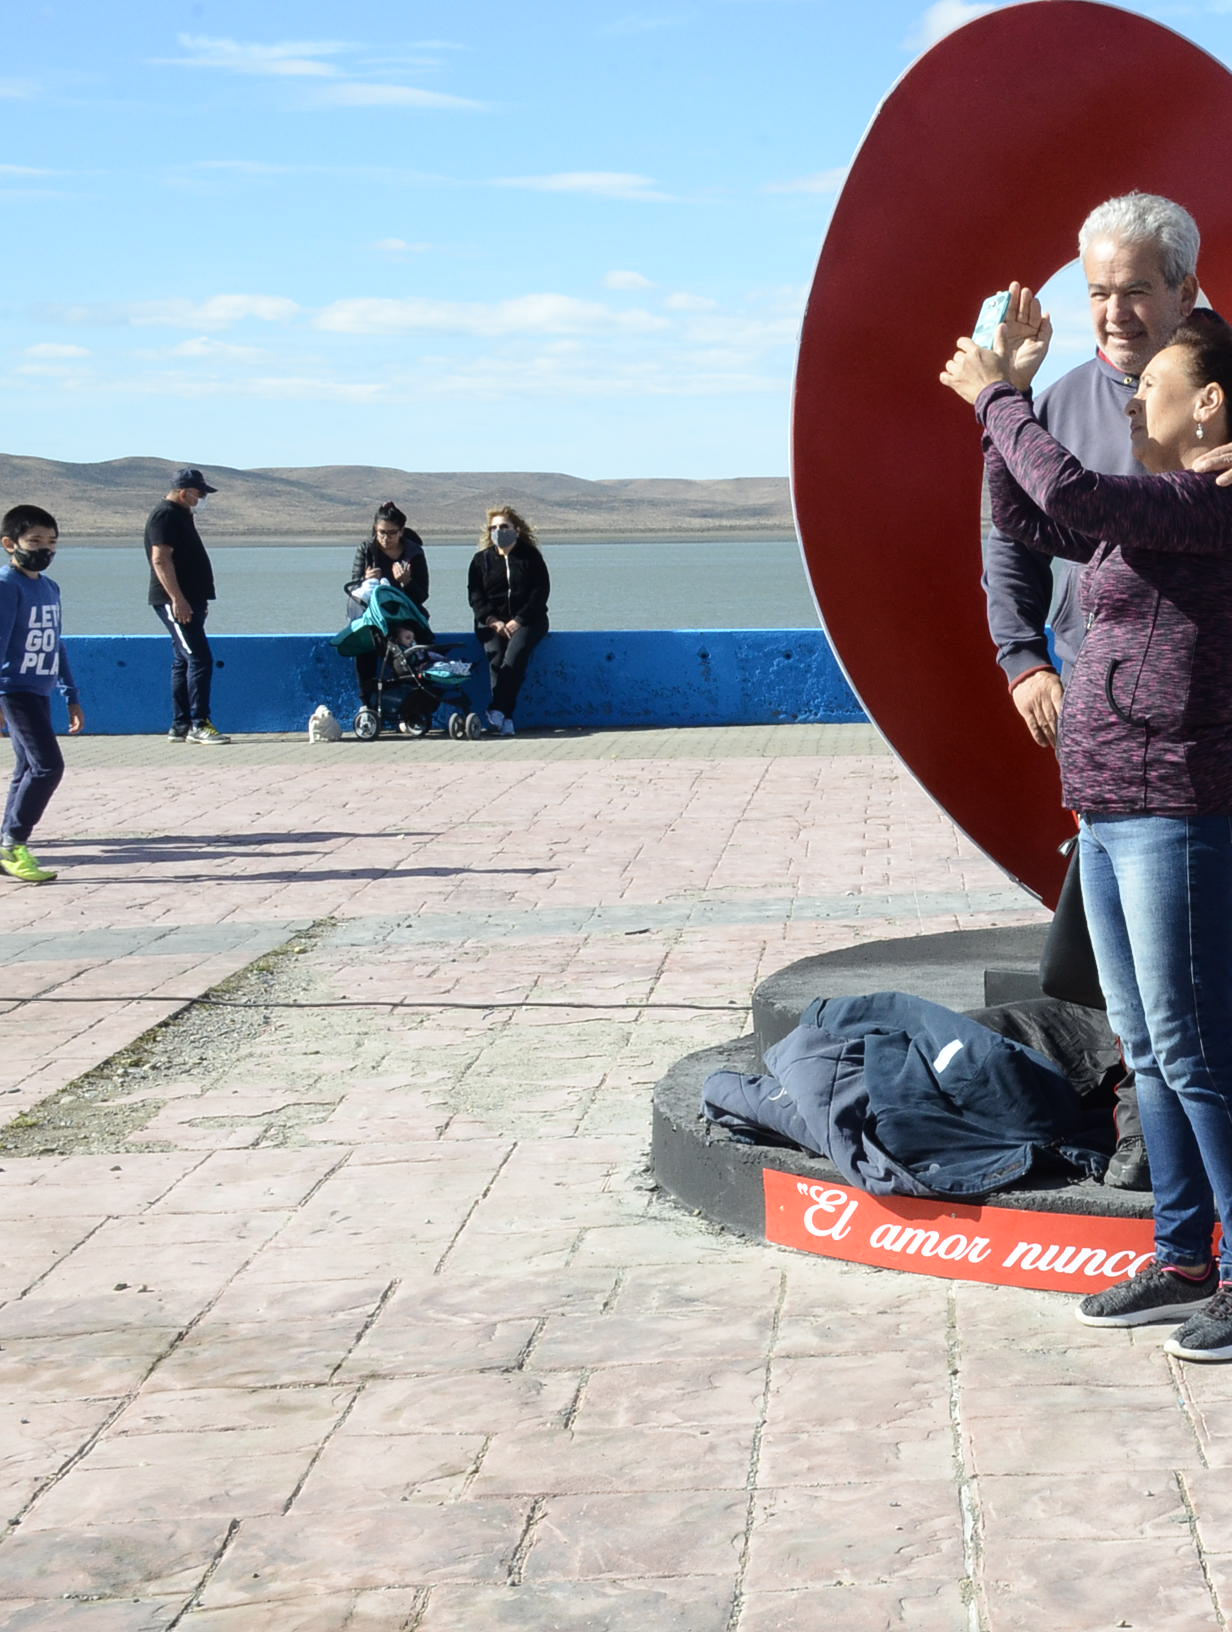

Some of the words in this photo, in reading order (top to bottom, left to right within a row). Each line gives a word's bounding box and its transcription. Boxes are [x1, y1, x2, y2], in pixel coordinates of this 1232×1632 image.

[28, 604, 59, 629] LET
[25, 628, 55, 652] GO
[19, 652, 59, 675] PLA
[869, 1222, 992, 1264] amor
